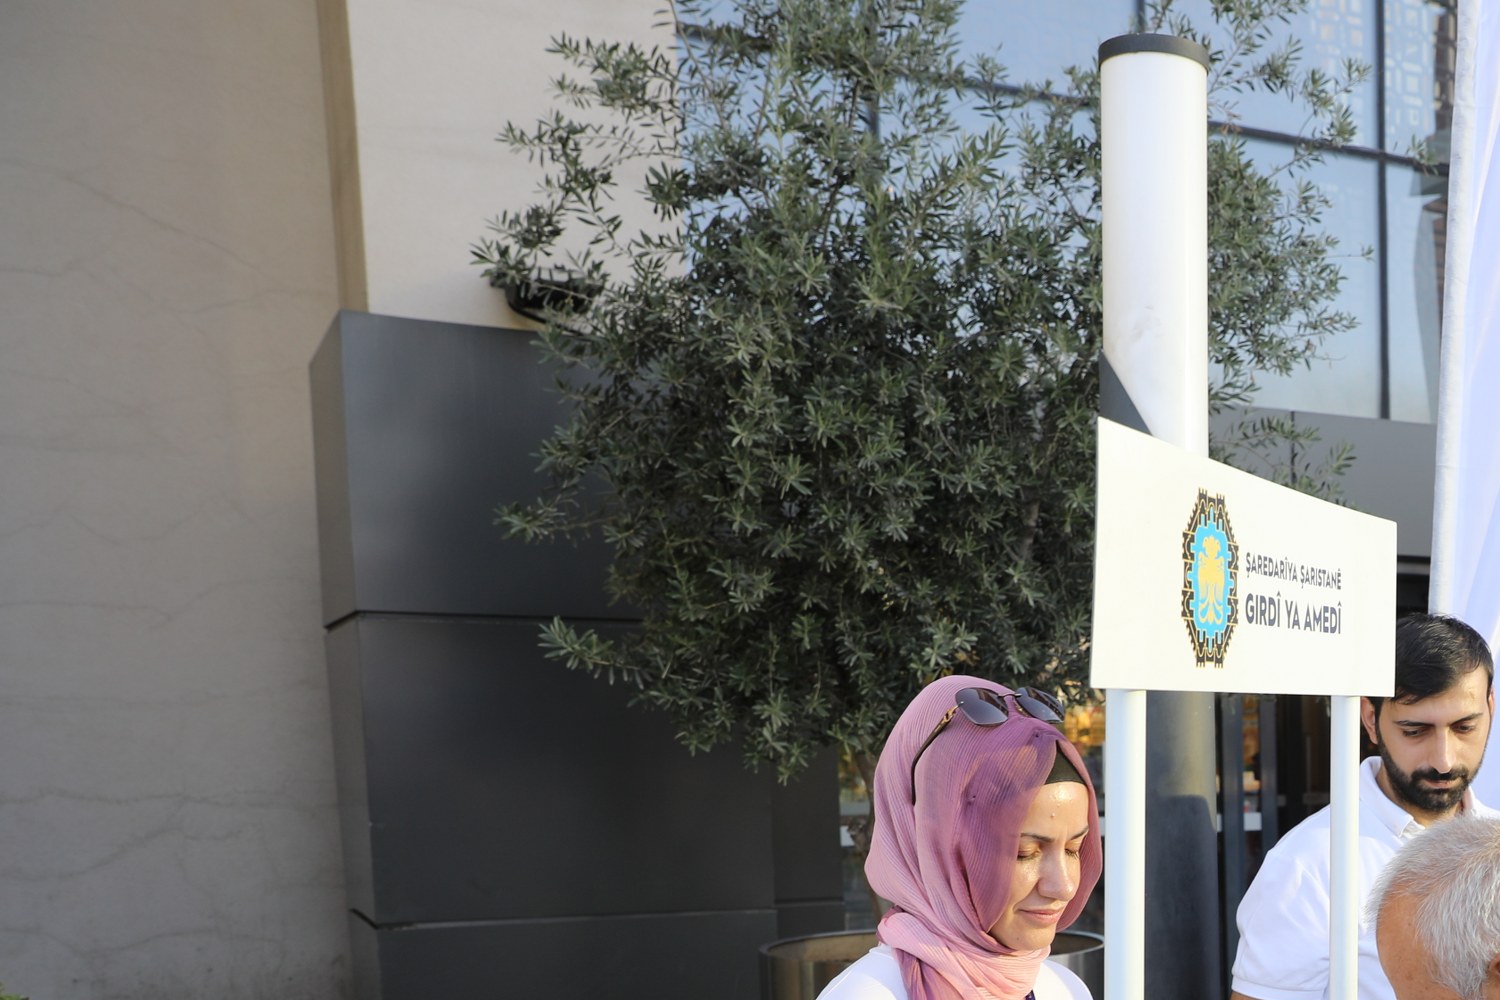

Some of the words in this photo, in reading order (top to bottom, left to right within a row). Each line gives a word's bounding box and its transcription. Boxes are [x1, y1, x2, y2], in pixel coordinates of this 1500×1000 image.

[1300, 564, 1342, 591] ŞARISTANÊ
[1245, 590, 1281, 628] GIRDÎ
[1285, 599, 1301, 631] YA
[1303, 600, 1342, 635] AMEDÎ
